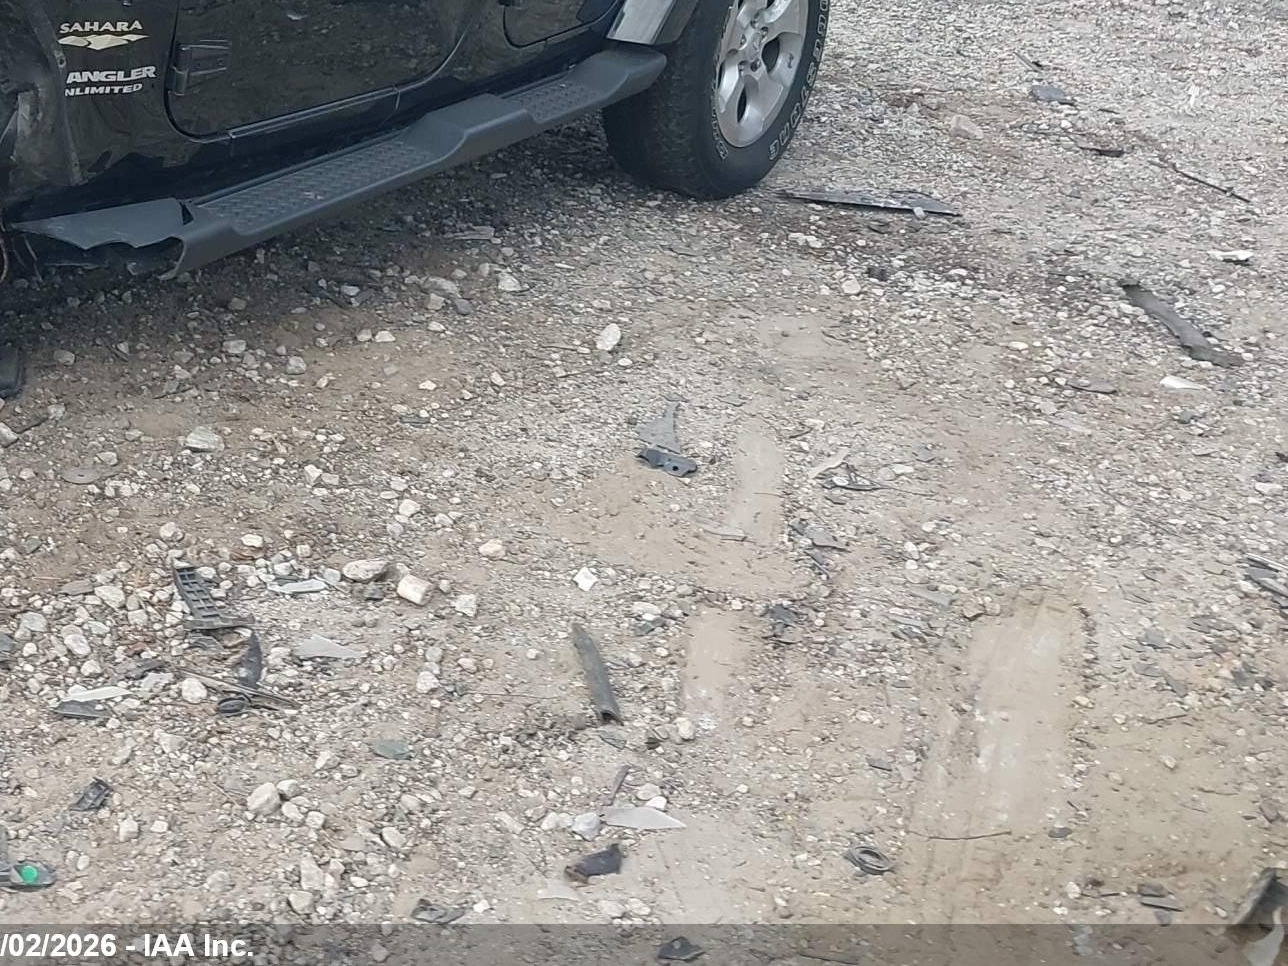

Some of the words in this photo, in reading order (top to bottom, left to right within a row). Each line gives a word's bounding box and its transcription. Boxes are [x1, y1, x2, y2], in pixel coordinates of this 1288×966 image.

[59, 19, 143, 34] SAHARA
[66, 65, 157, 84] ANGLER
[64, 83, 143, 97] NLIMITED
